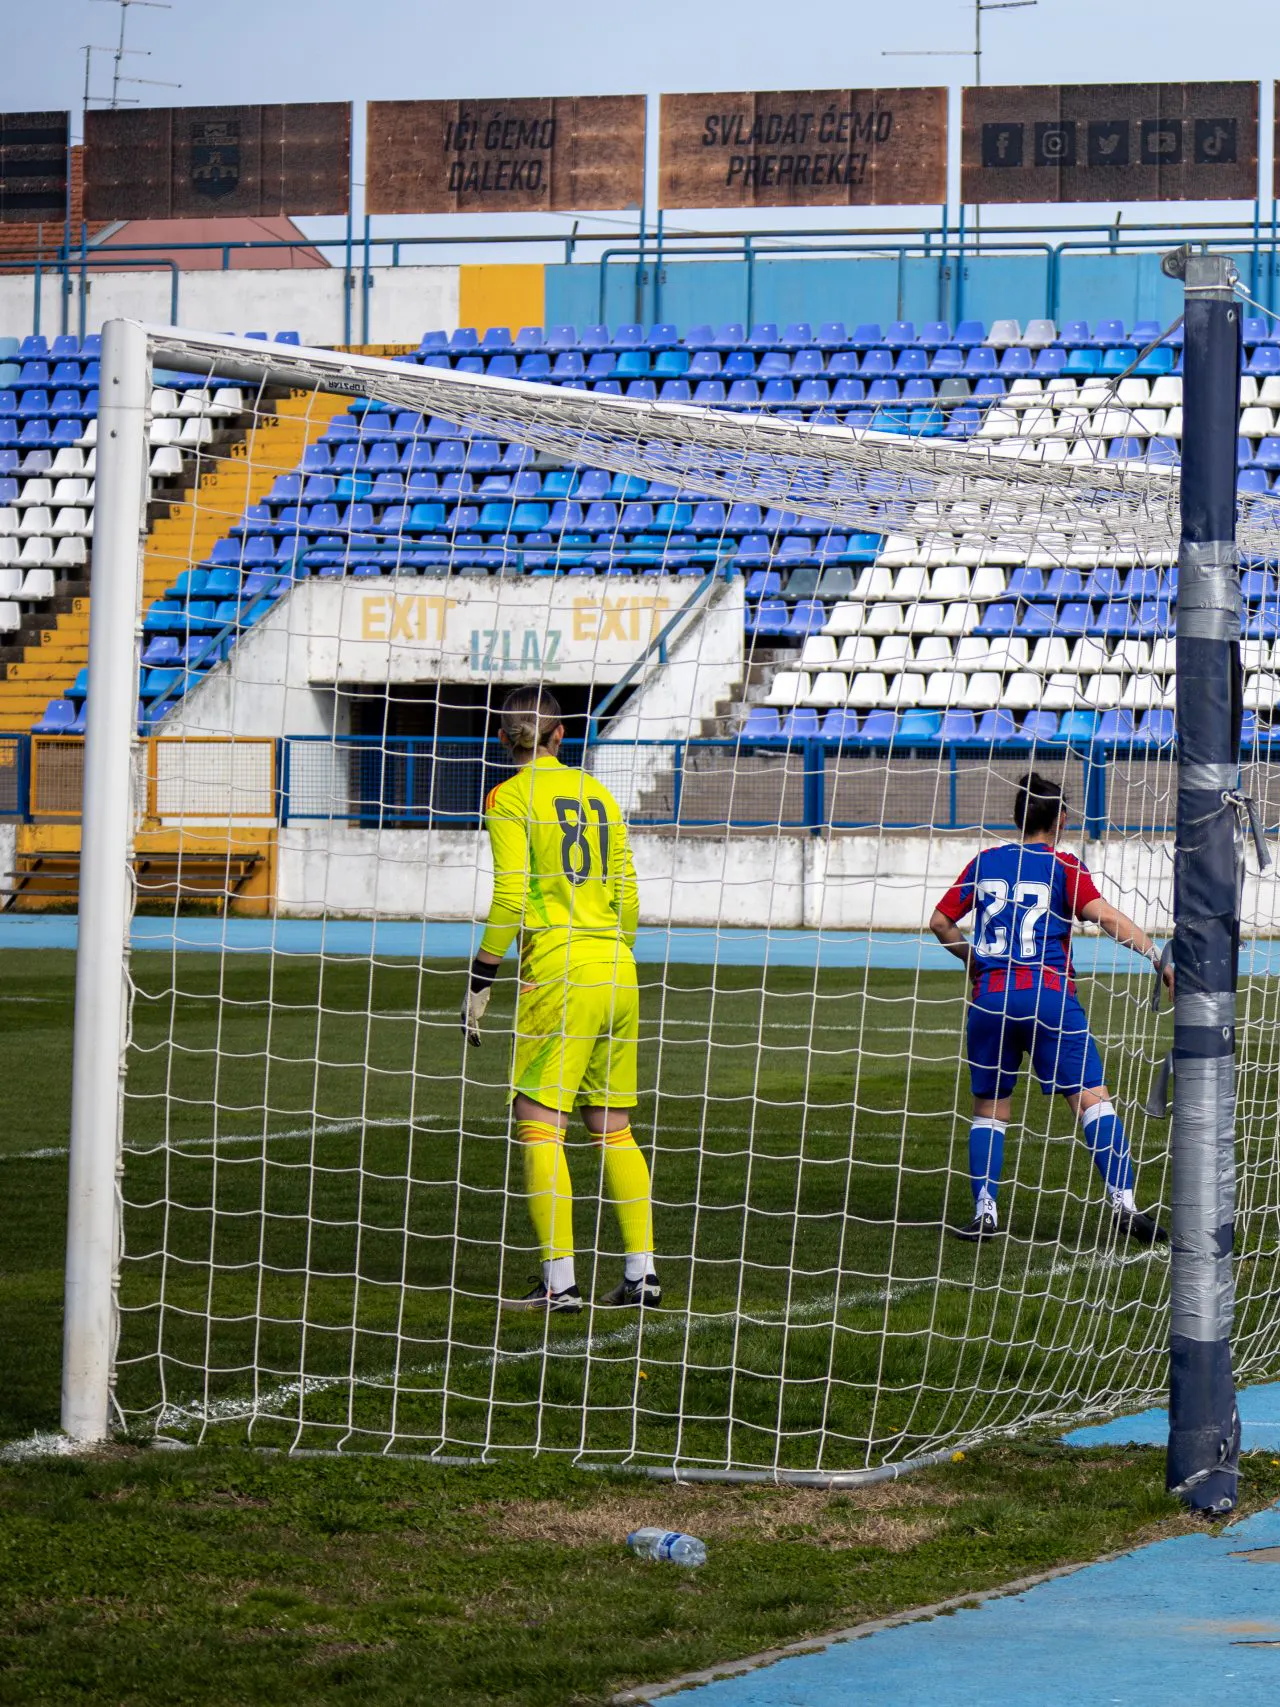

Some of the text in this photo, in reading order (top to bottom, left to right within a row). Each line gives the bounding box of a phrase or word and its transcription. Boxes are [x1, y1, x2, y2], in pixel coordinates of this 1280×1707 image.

[444, 112, 556, 151] IĆI ĆEMO
[702, 104, 893, 146] SVLADAT ĆEMO
[448, 160, 548, 196] DALEKO,
[726, 153, 868, 186] PREPREKE!
[263, 416, 279, 427] 12
[232, 445, 247, 456] 11
[74, 599, 82, 611] 6
[362, 596, 456, 641] EXIT
[573, 596, 669, 641] EXIT
[44, 632, 51, 643] 5
[470, 629, 562, 671] IZLAZ
[552, 796, 611, 887] 81
[976, 878, 1051, 957] 27
